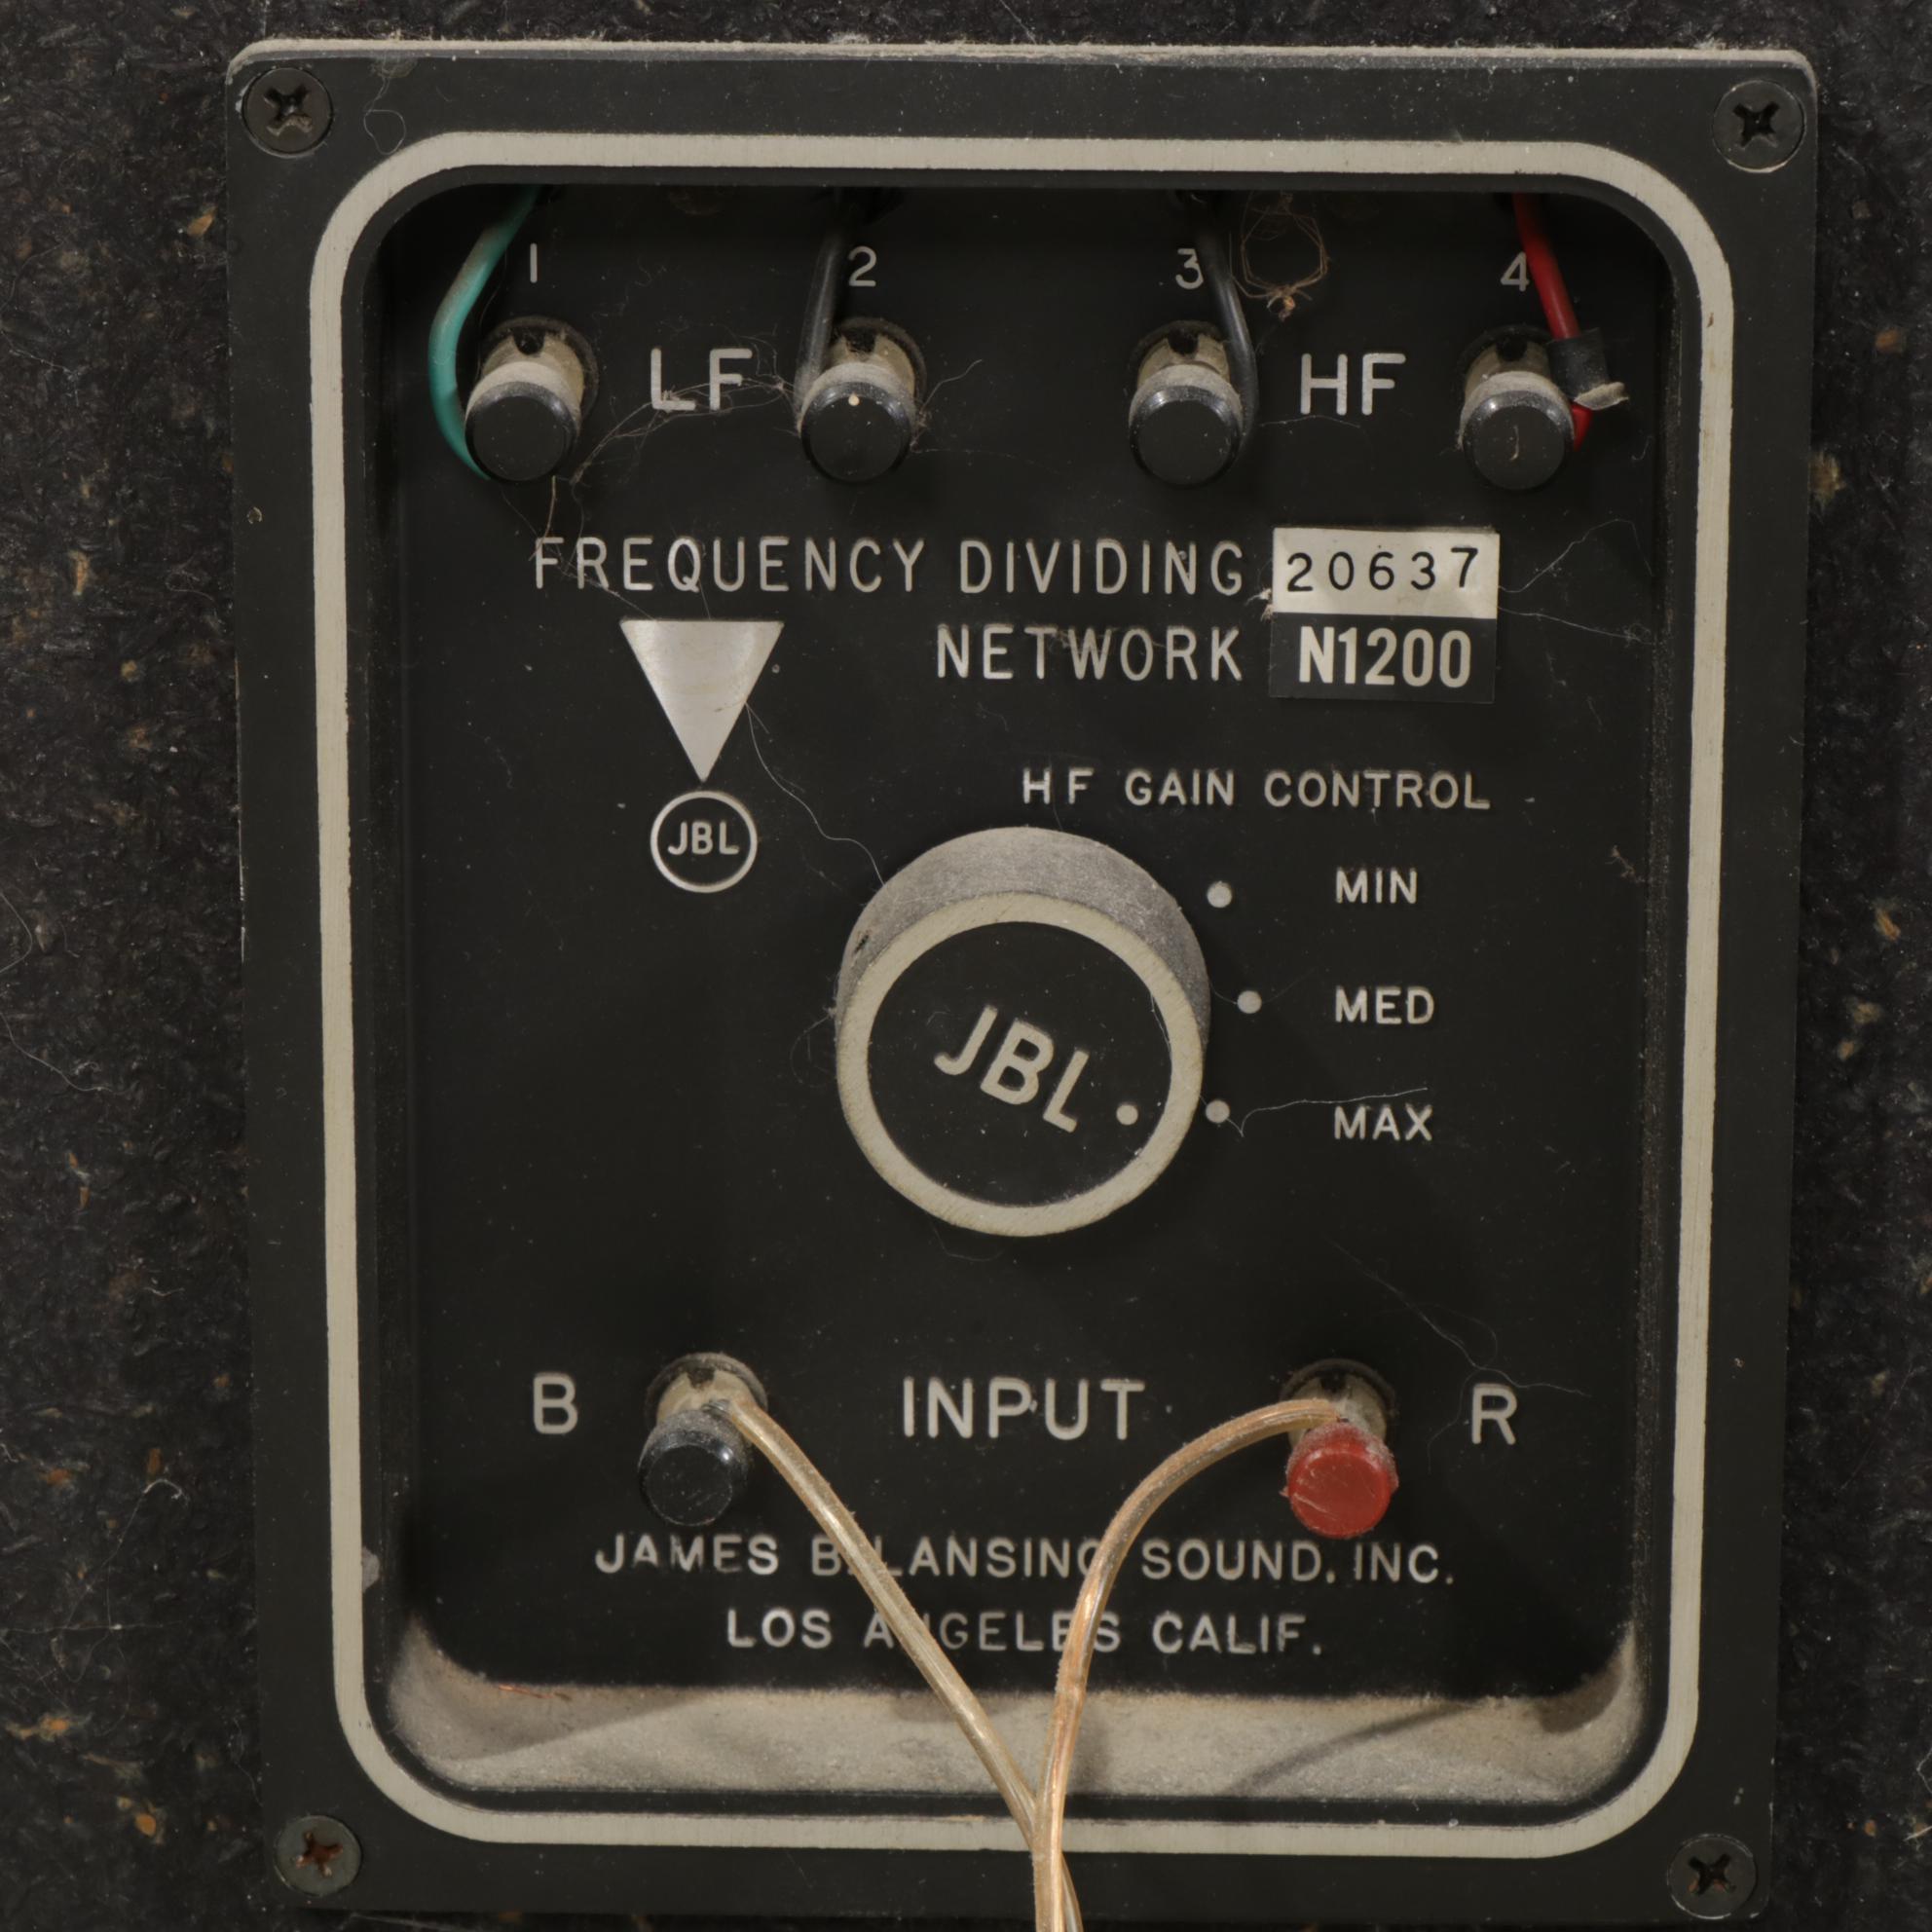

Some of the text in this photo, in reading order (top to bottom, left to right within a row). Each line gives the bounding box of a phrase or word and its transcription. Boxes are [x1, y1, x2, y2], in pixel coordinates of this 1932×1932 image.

[848, 246, 877, 287] 2
[1175, 248, 1205, 290] 3
[1500, 252, 1530, 292] 4
[650, 348, 753, 411] LF
[1299, 352, 1406, 416] HF
[534, 535, 1245, 596] FREQUENCY DIVIDING
[1286, 547, 1478, 592] 20637
[936, 622, 1243, 682] NETWORK
[1298, 625, 1471, 688] N1200
[1124, 767, 1235, 806] GAIN
[1263, 769, 1491, 810] CONTROL
[667, 820, 740, 856] JBL
[1334, 867, 1419, 905] MIN
[1334, 985, 1435, 1025] MED
[933, 1005, 1090, 1133] JBL
[1334, 1102, 1433, 1141] MAX
[533, 1371, 579, 1434] B
[903, 1375, 1146, 1441] INPUT
[1470, 1383, 1518, 1445] R
[594, 1533, 779, 1576] JAMES
[1354, 1542, 1455, 1585] INC.
[726, 1607, 1322, 1655] LOS AGELES CALIF.
